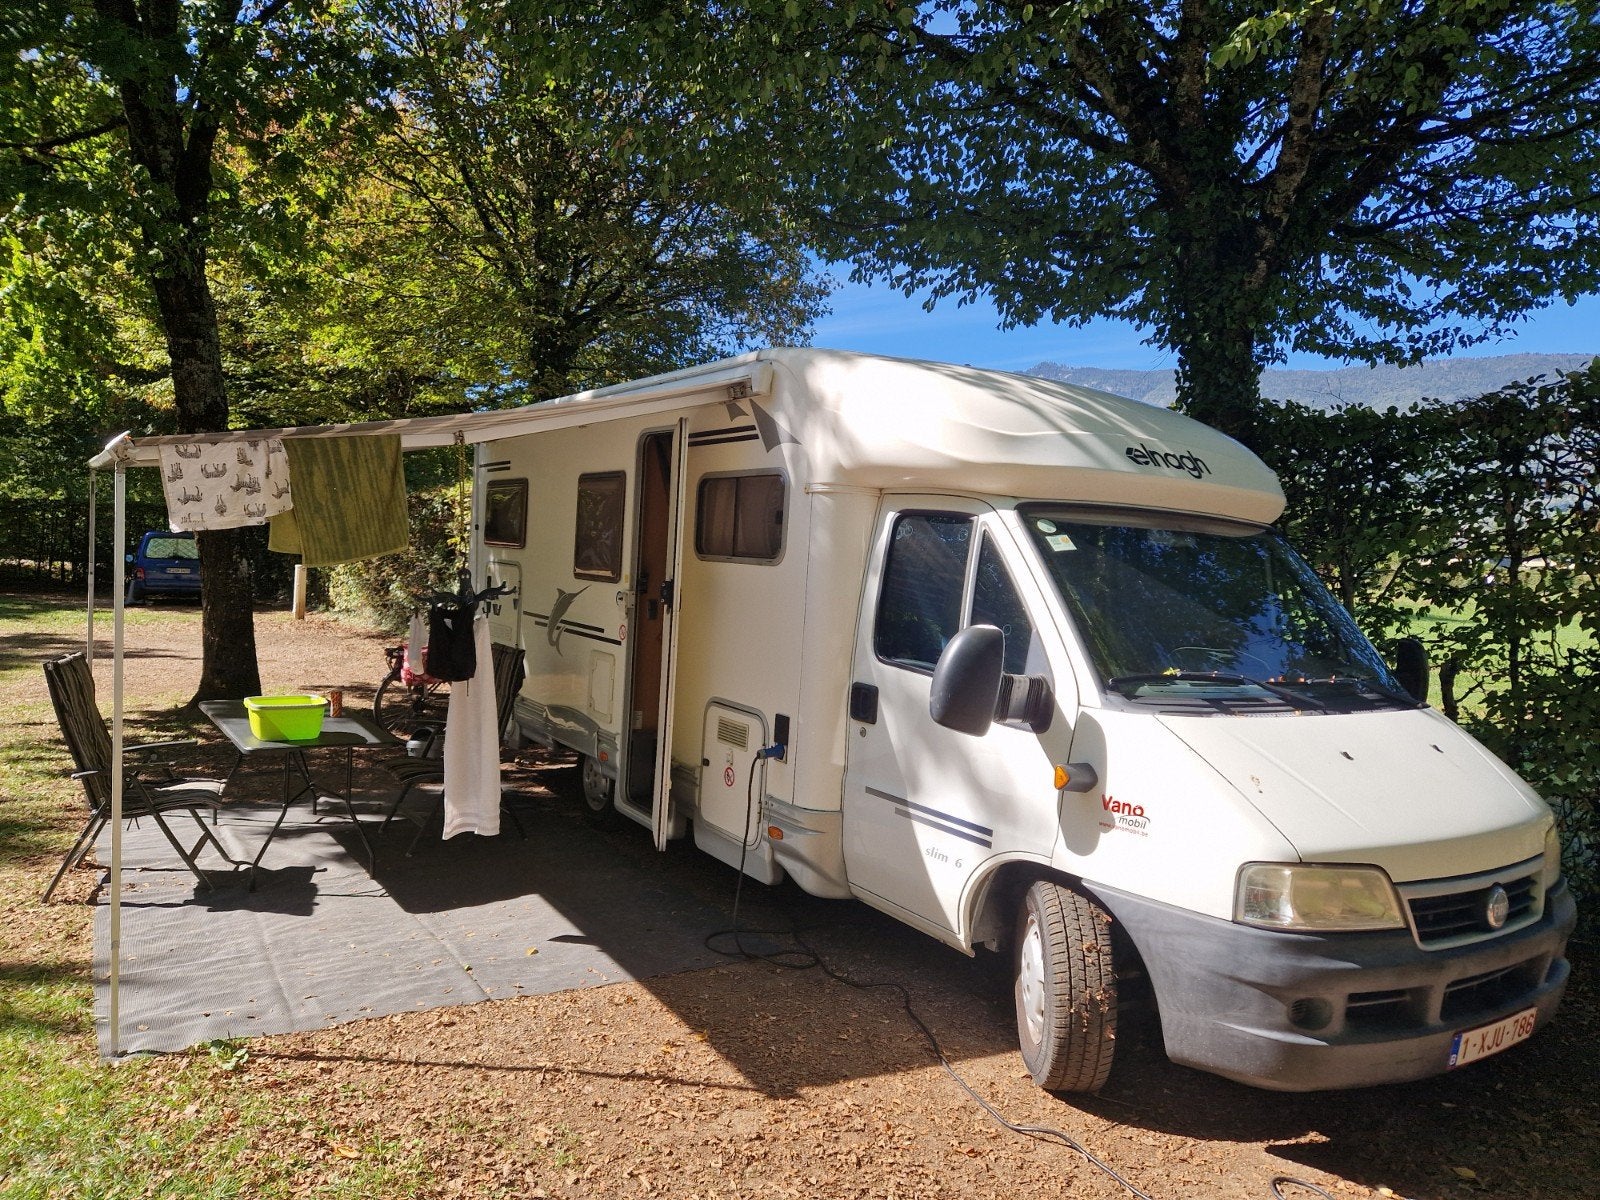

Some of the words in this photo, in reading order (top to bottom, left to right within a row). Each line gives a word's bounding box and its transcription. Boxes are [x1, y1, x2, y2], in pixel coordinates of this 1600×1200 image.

[1126, 443, 1212, 479] elnagh
[1101, 794, 1145, 817] Vano
[1118, 817, 1147, 829] mobil
[925, 847, 948, 863] slim
[955, 858, 963, 868] 6
